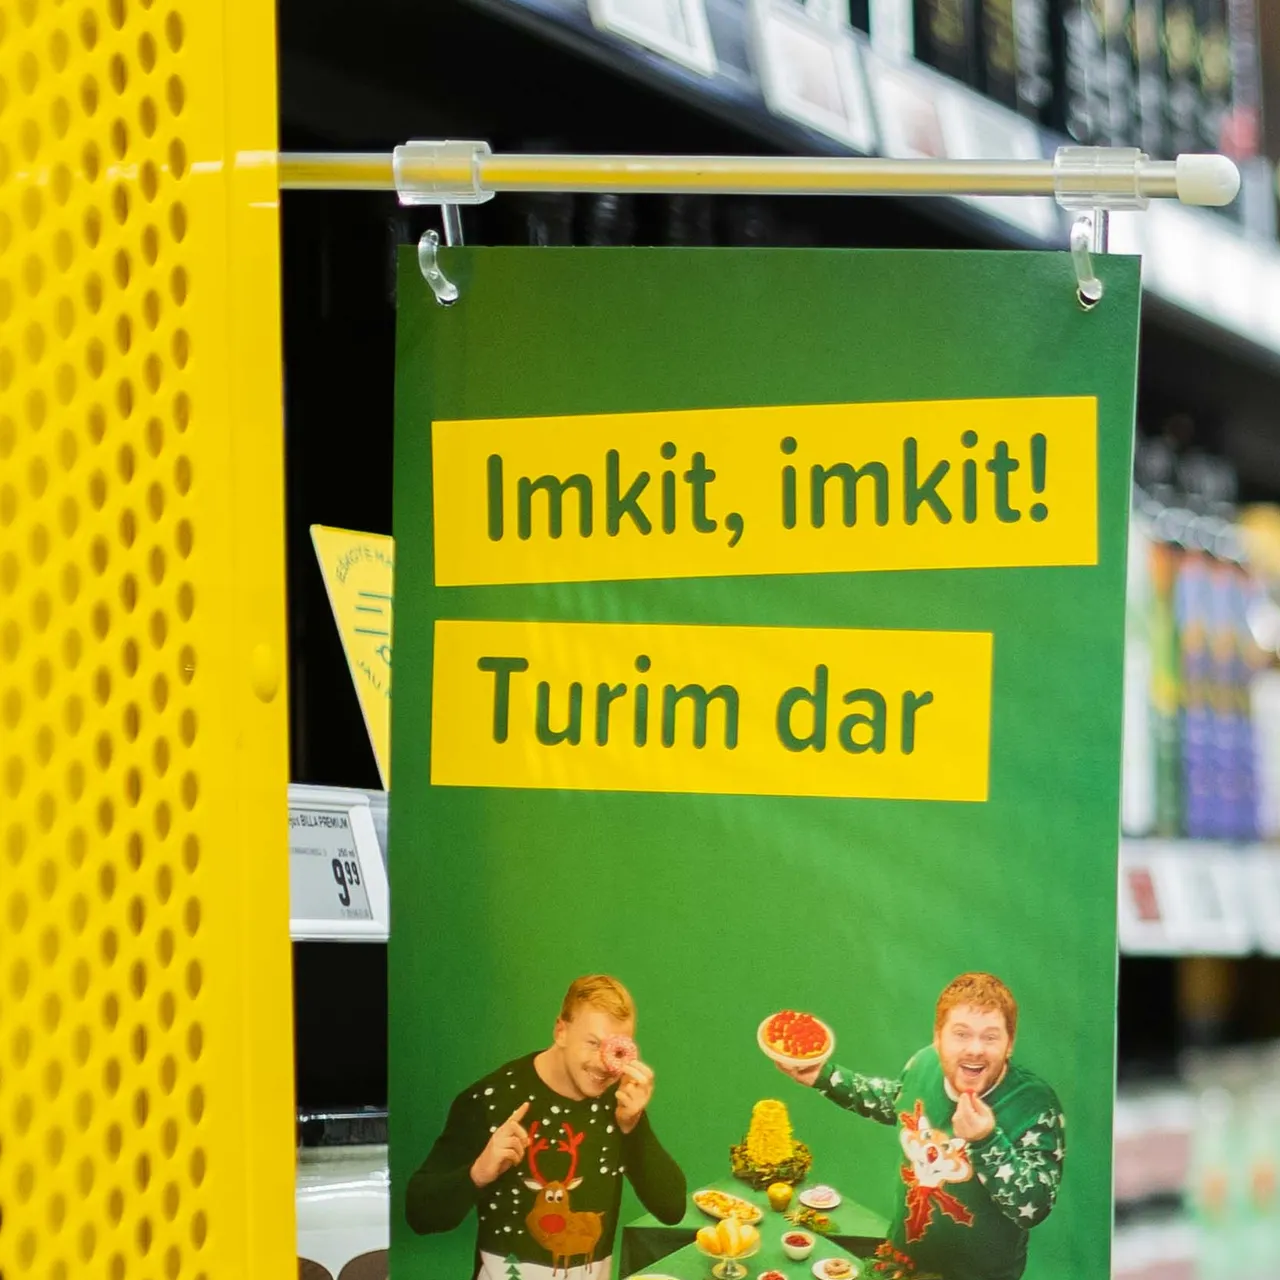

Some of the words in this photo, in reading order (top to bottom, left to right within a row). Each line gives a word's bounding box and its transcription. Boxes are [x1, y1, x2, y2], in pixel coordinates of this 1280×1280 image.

[486, 440, 745, 548] Imkit,
[780, 430, 1050, 530] imkit!
[477, 654, 741, 750] Turim
[775, 663, 935, 756] dar
